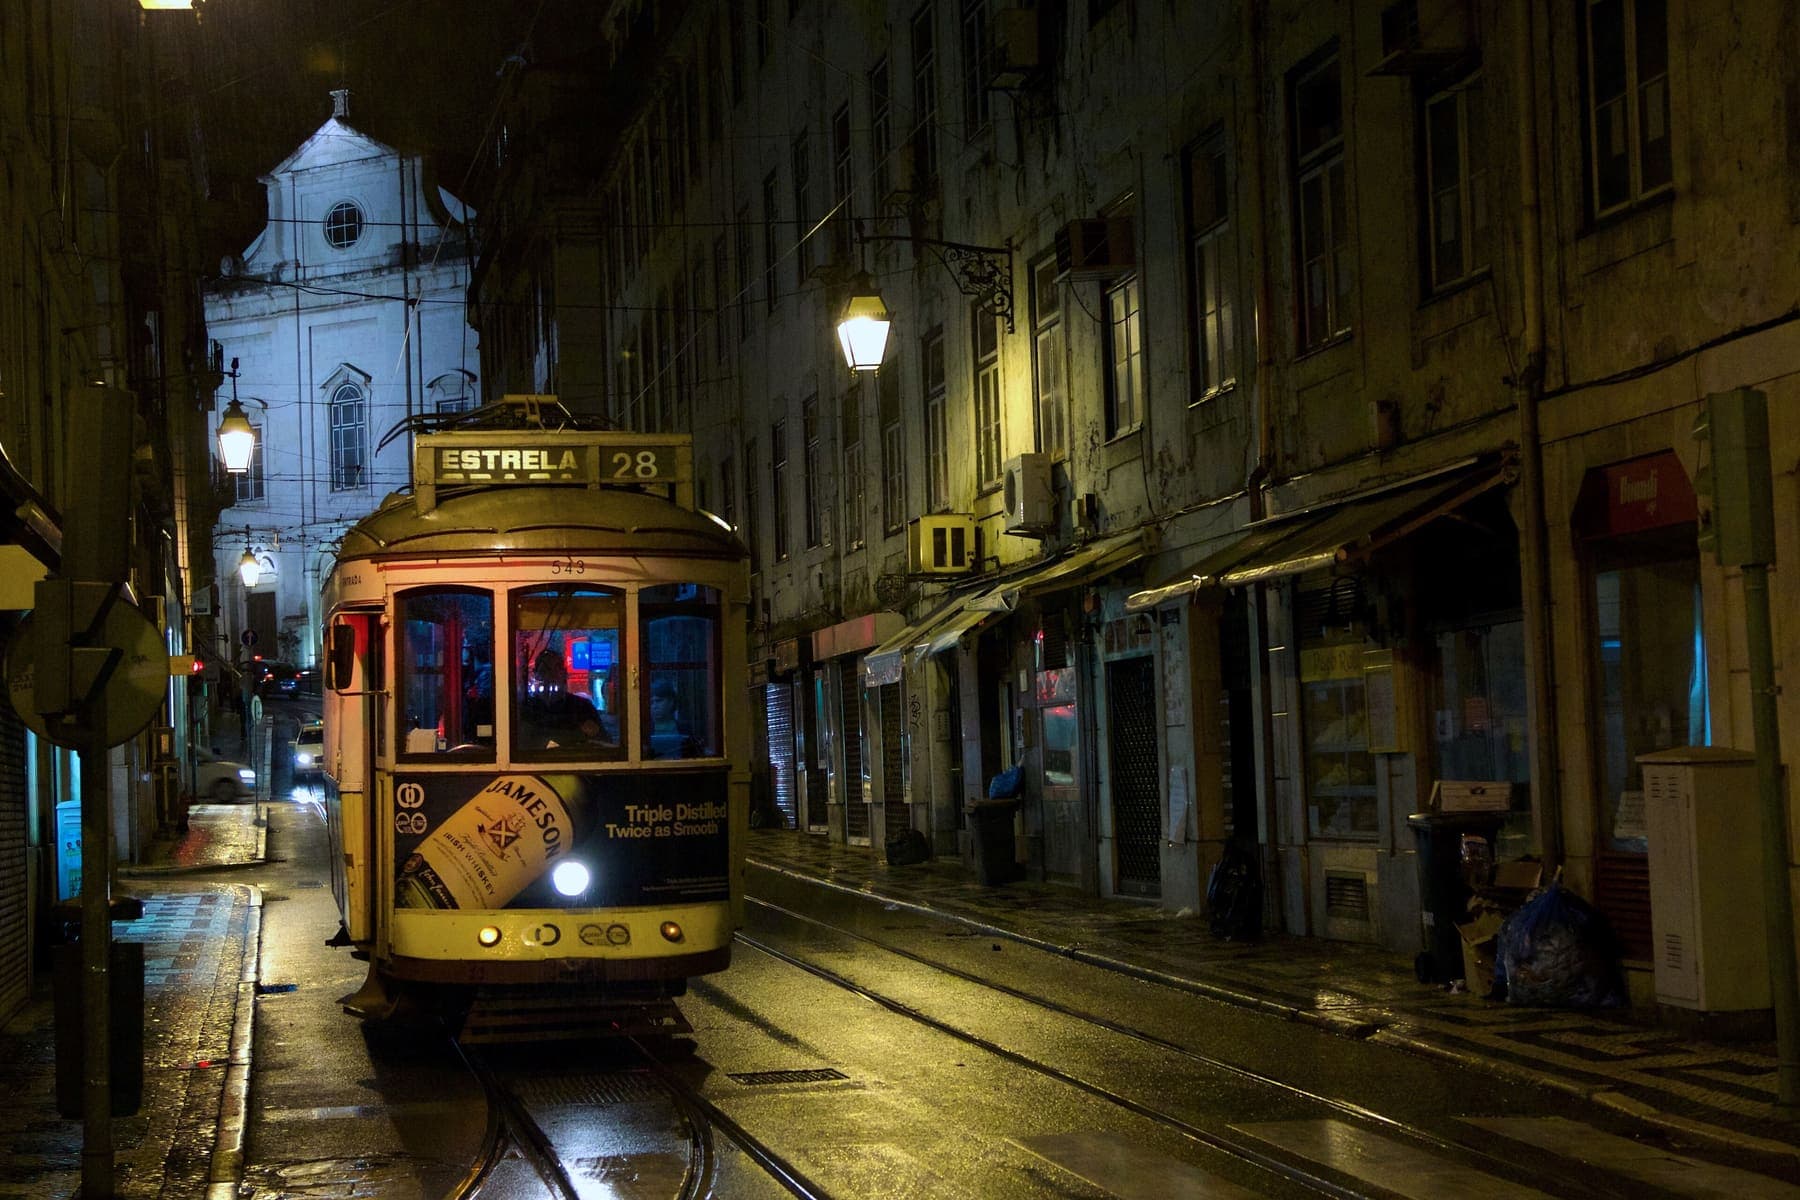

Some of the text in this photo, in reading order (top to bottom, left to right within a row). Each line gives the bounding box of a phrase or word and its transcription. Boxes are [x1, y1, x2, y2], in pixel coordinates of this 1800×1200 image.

[442, 450, 578, 470] ESTRELA
[612, 451, 658, 479] 28
[551, 559, 585, 575] 543
[486, 781, 561, 860] JAMESON
[625, 801, 727, 826] Triple Distilled
[605, 823, 652, 839] Twice
[654, 825, 671, 837] as
[443, 832, 466, 852] IRISH
[465, 852, 496, 896] WHISKEY
